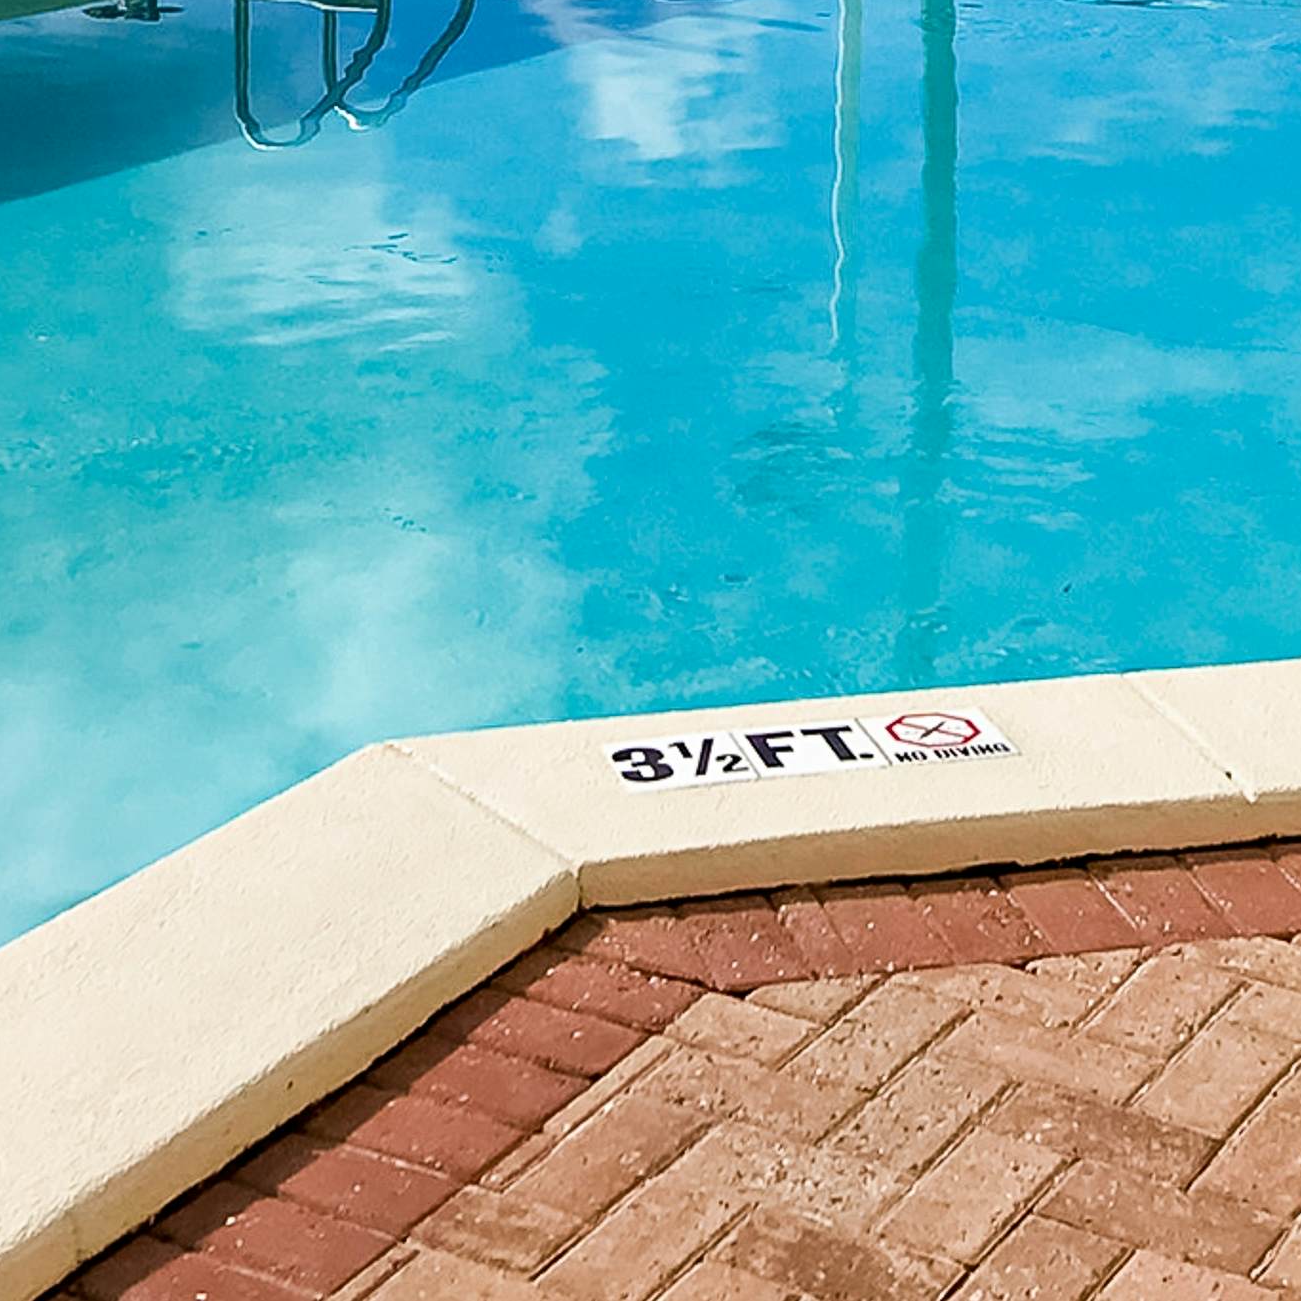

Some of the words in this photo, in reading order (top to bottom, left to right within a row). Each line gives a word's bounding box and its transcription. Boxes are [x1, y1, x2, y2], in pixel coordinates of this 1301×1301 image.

[744, 725, 875, 769] FT.
[894, 750, 928, 763] NO
[932, 742, 1011, 760] DIVING
